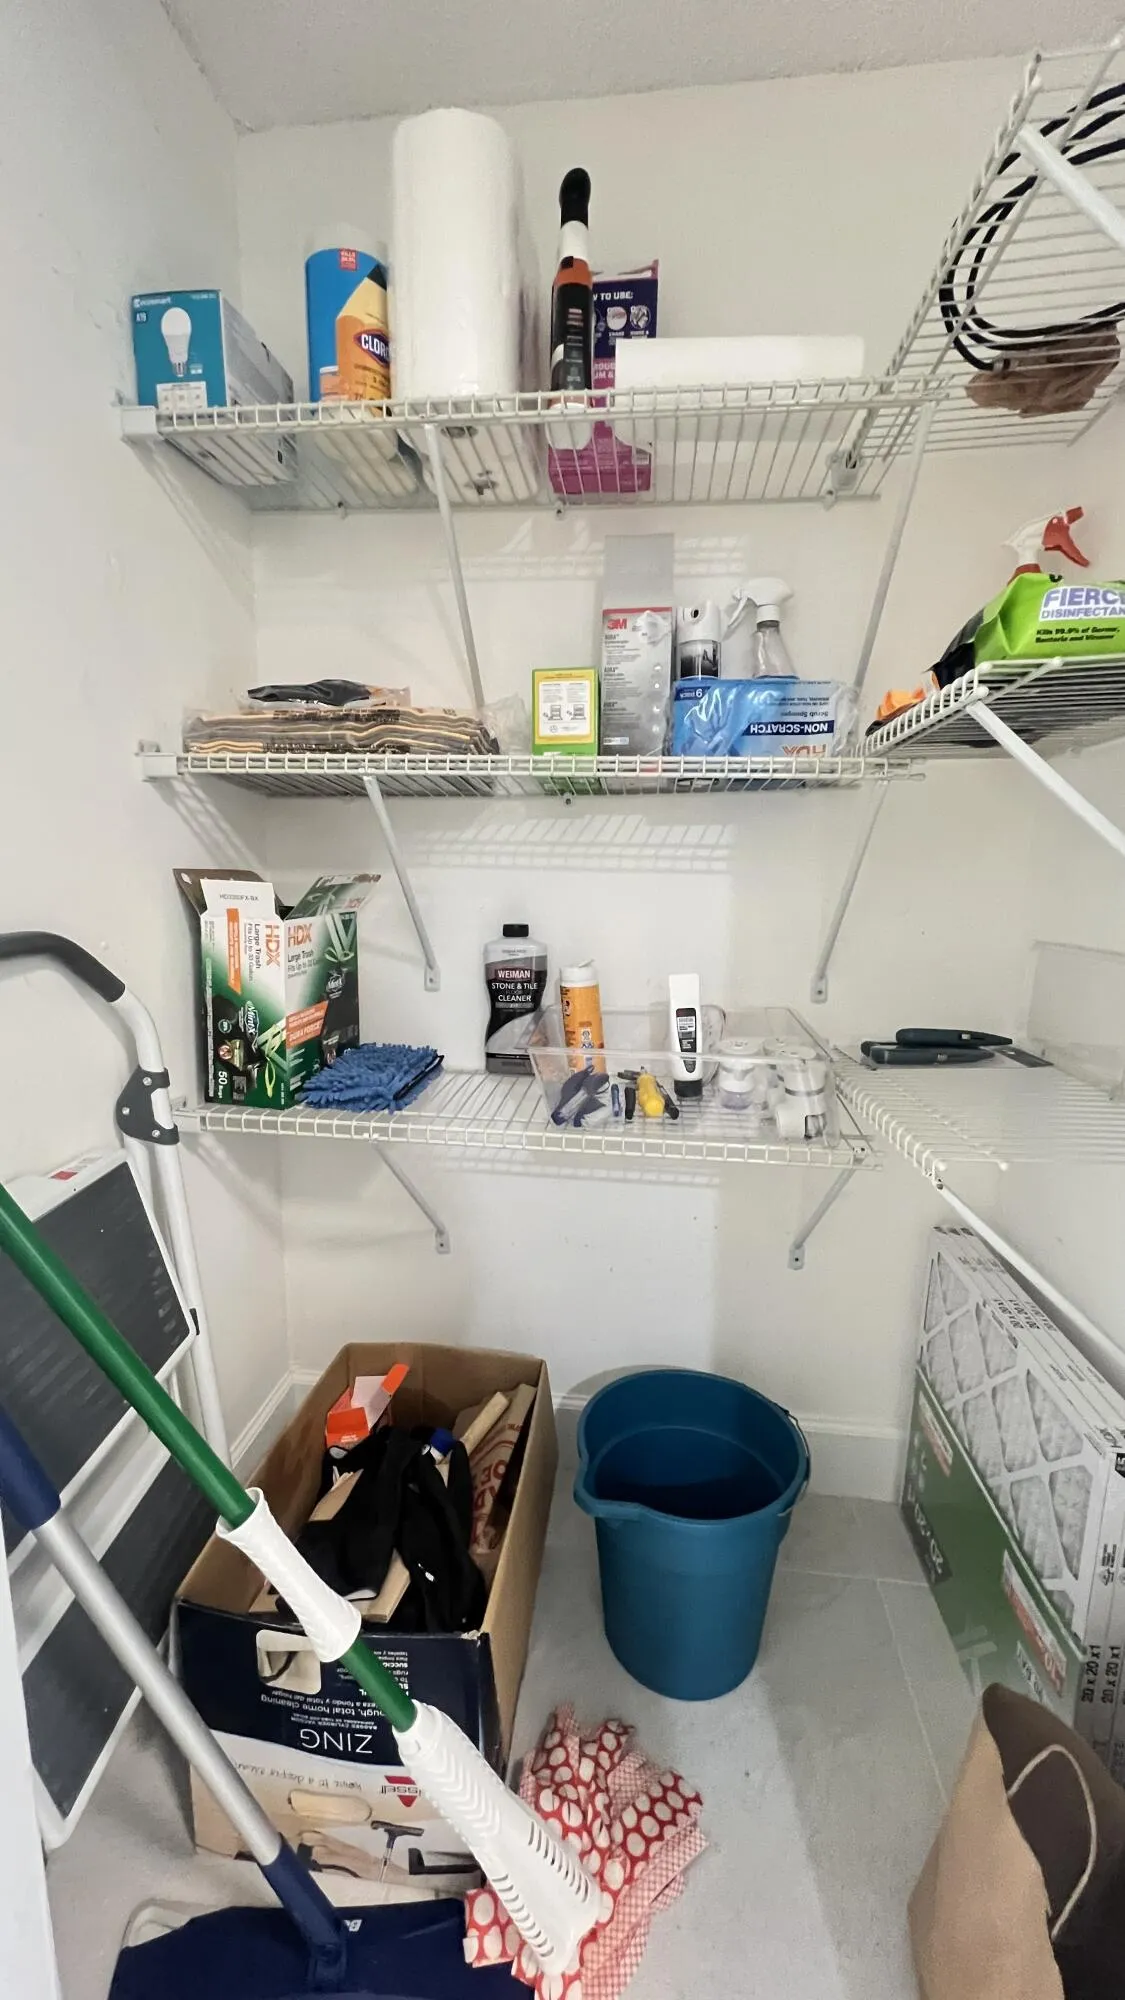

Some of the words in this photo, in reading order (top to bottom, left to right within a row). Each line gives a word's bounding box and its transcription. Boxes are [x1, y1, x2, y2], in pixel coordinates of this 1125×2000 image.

[600, 292, 611, 300] TO
[607, 618, 627, 630] 3M
[696, 688, 703, 698] 9
[750, 722, 828, 734] NON-SCRATCH
[247, 936, 253, 944] Up
[287, 923, 312, 948] HDX
[265, 925, 281, 967] HDX
[288, 953, 301, 963] Large
[498, 970, 530, 978] WEIMAN
[524, 982, 538, 990] TILE
[218, 1071, 228, 1084] 50
[1085, 1661, 1098, 1676] 20
[1105, 1662, 1118, 1677] 20
[272, 1691, 292, 1699] hogar
[1080, 1688, 1094, 1703] 20
[1101, 1689, 1114, 1703] 20
[260, 1694, 300, 1710] cleaning
[302, 1704, 330, 1714] home
[299, 1728, 373, 1754] ZING
[380, 1786, 422, 1796] issell
